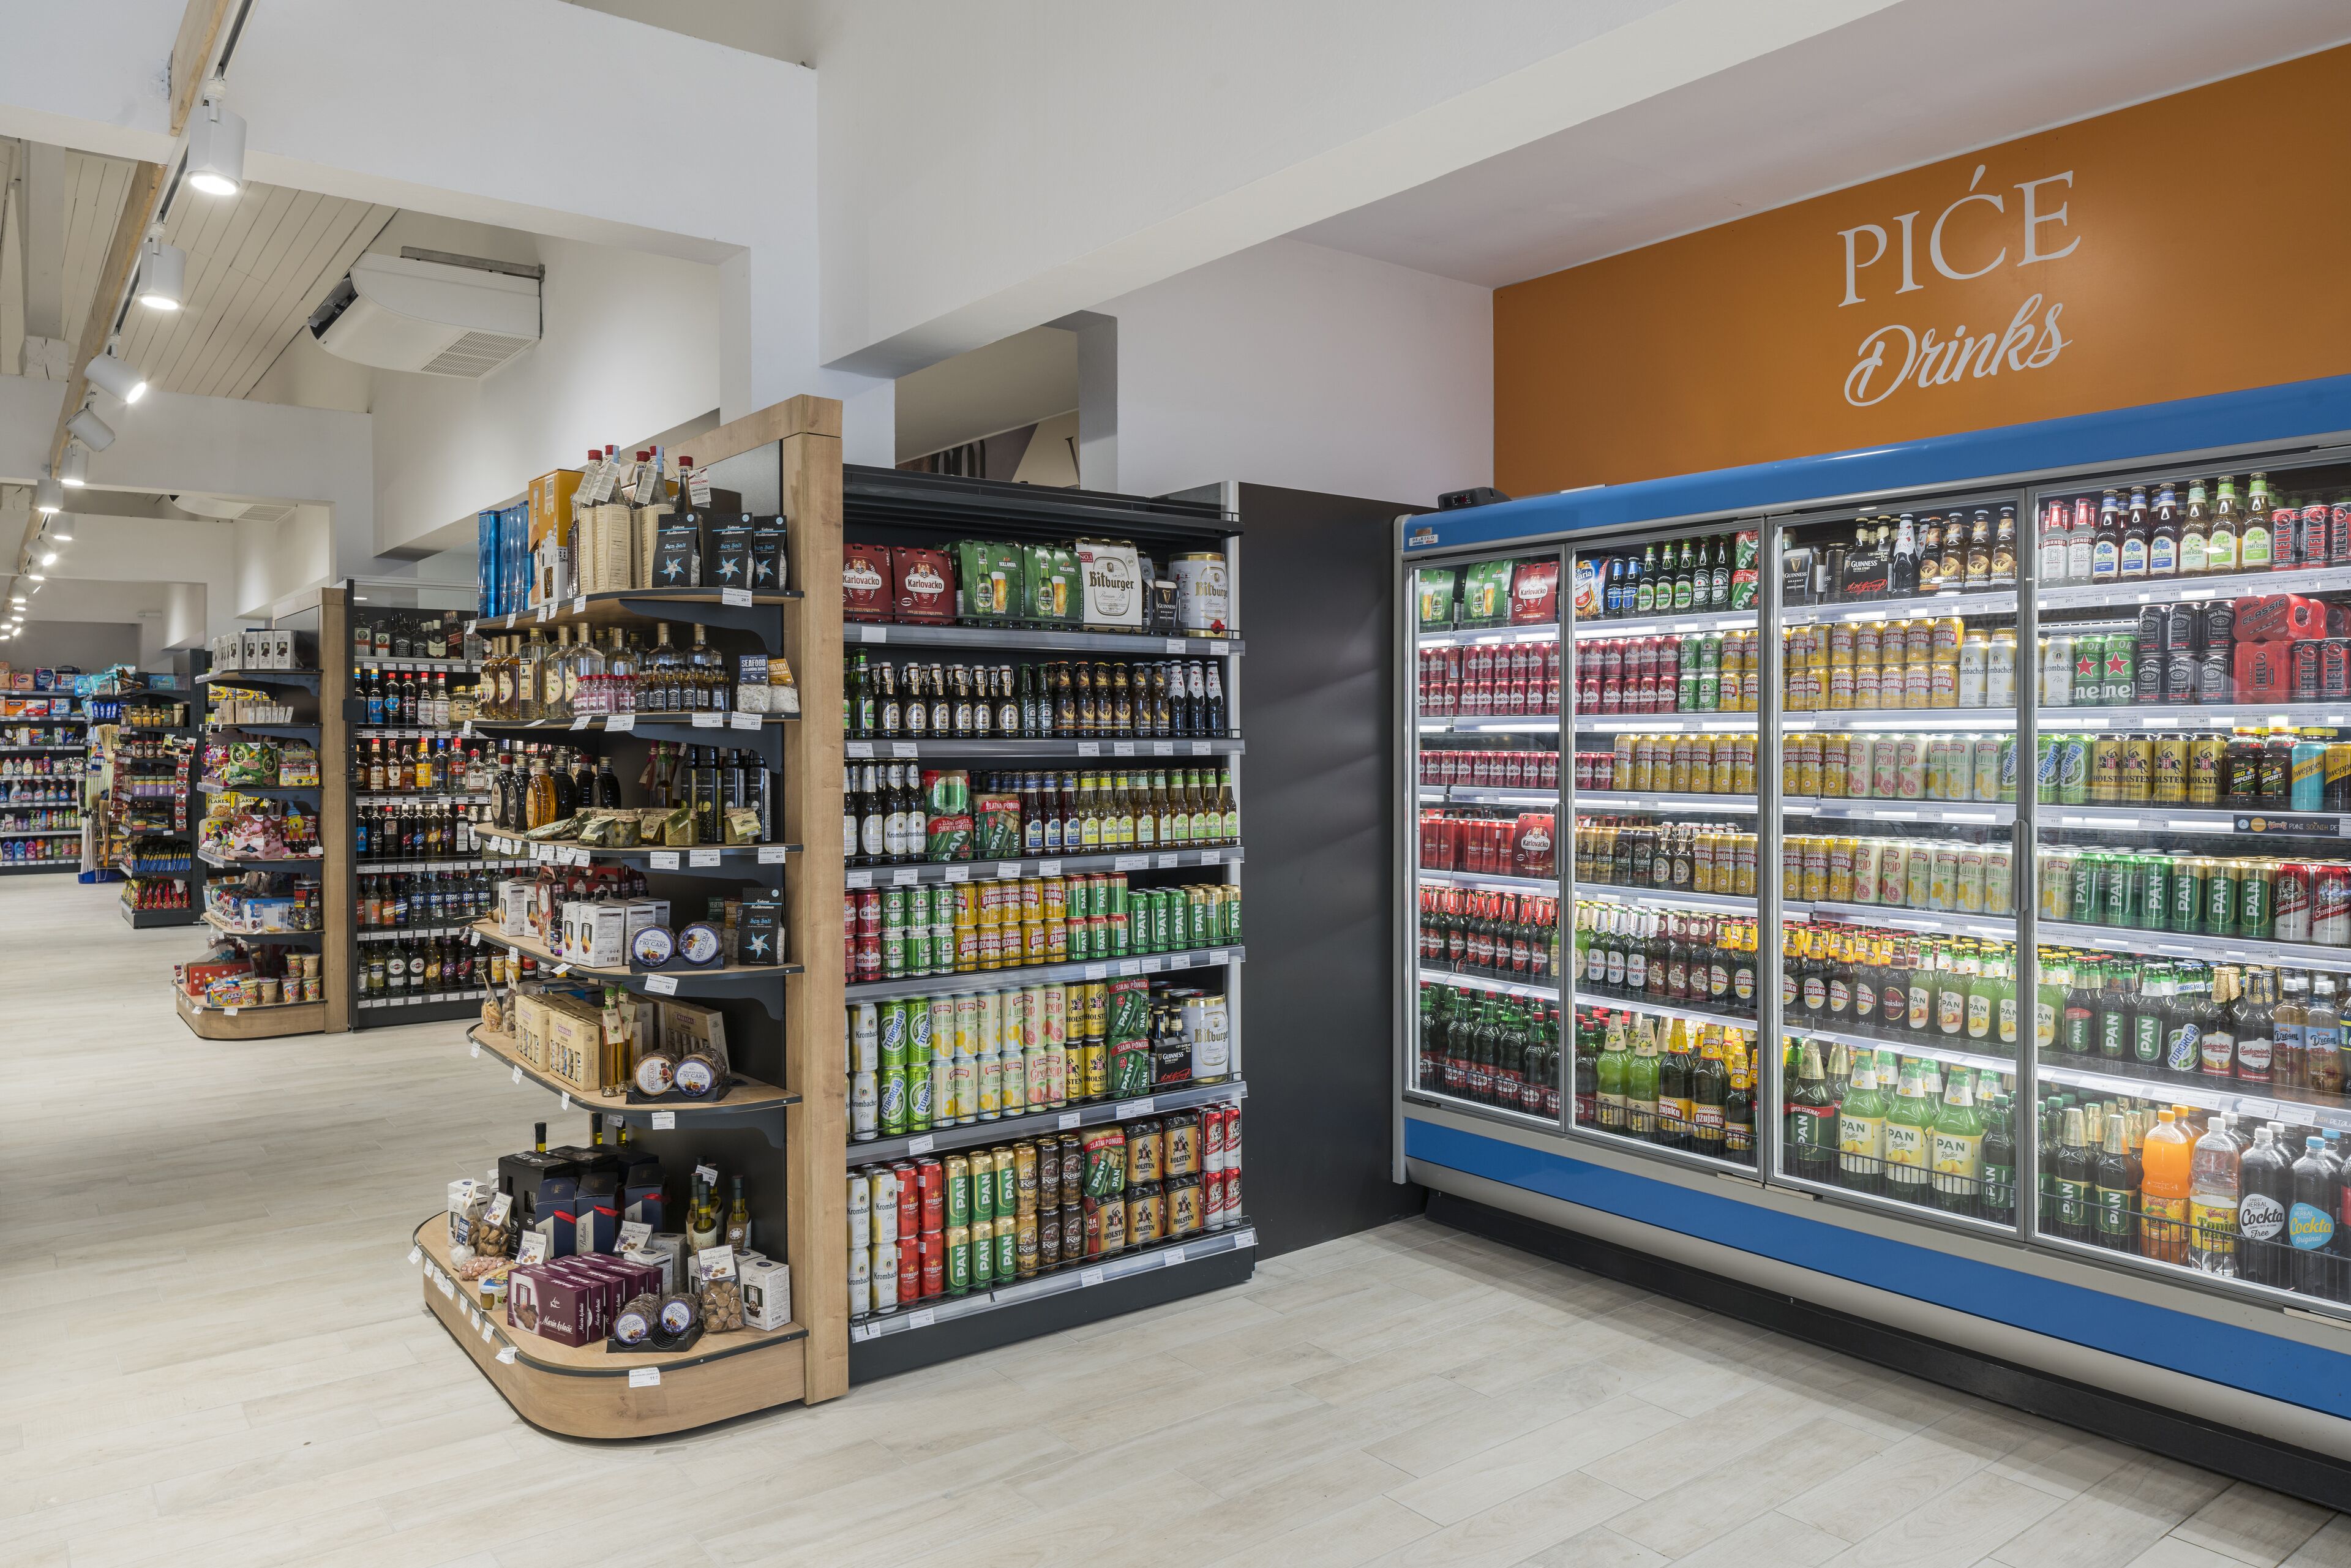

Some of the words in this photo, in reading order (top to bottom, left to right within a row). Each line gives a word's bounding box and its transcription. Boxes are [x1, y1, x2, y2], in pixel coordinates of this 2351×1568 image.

[1837, 165, 2080, 307] PIĆE
[1845, 293, 2073, 407] Drinks
[2308, 525, 2325, 557] HELL
[2332, 522, 2347, 557] HELL
[842, 575, 879, 585] Karlovačko
[1520, 588, 1546, 596] Karlovačko
[2300, 659, 2317, 691] HELL
[2327, 658, 2344, 691] HELL
[942, 830, 966, 861] PAN
[990, 823, 1004, 849] PAN
[2076, 871, 2085, 903] PAN
[2110, 874, 2121, 906] PAN
[1910, 996, 1926, 1004] PAN
[1969, 1003, 1986, 1011] PAN
[1119, 1002, 1132, 1027] PAN
[2106, 1015, 2118, 1048] PAN
[1841, 1119, 1865, 1133] PAN
[1937, 1138, 1965, 1152] PAN
[1092, 1160, 1106, 1188] PAN
[956, 1180, 966, 1209] PAN
[2241, 1207, 2283, 1226] Cockta
[2290, 1217, 2332, 1235] Cockta
